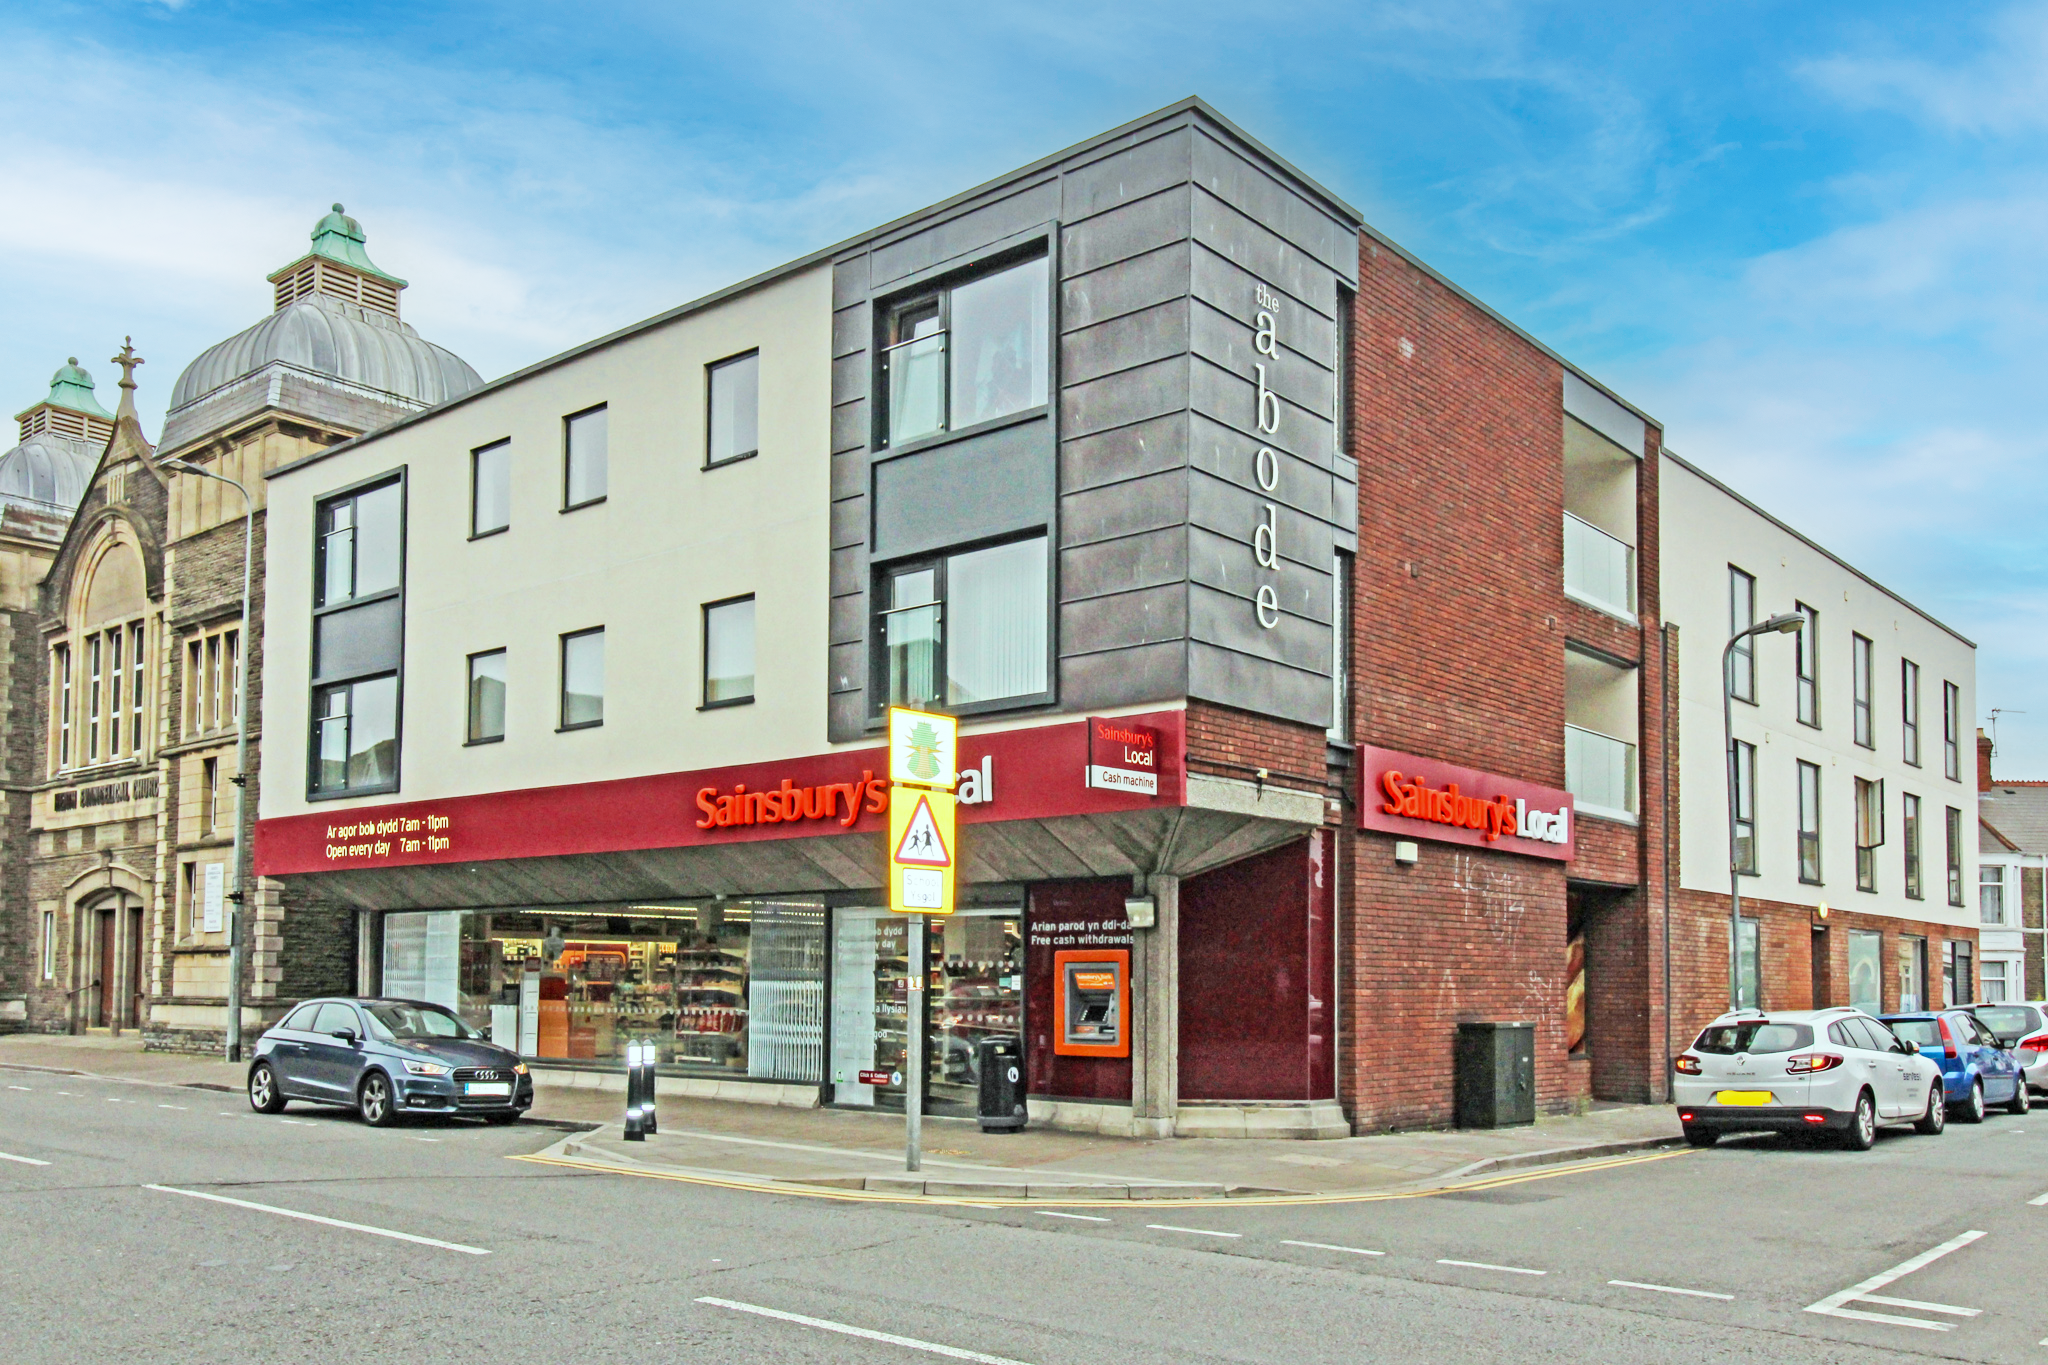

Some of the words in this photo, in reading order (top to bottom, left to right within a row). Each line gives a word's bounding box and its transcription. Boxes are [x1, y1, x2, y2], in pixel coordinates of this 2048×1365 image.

[1255, 283, 1280, 314] the
[1254, 310, 1281, 630] abode
[1097, 723, 1154, 749] Sainsbury's
[1124, 745, 1153, 767] Local
[133, 775, 160, 800] CHURC
[1102, 770, 1122, 784] Cash
[1123, 775, 1154, 789] machine
[696, 769, 888, 829] Sainsbury's
[1383, 770, 1516, 842] Sainsbury's
[1515, 798, 1569, 844] Local
[326, 825, 337, 839] Ar
[338, 824, 358, 841] agor
[359, 821, 376, 836] bob
[376, 818, 399, 837] dydd
[400, 817, 420, 832] 7am
[427, 814, 449, 832] 11pm
[326, 844, 348, 860] Open
[349, 843, 374, 858] every
[374, 840, 391, 857] day
[400, 837, 420, 852] 7am
[428, 835, 449, 853] 11pm
[1031, 921, 1057, 932] Arian
[1058, 920, 1085, 932] parod
[1088, 921, 1100, 932] yn
[881, 940, 896, 949] day
[1031, 935, 1051, 945] Free
[1053, 935, 1075, 944] cash
[1077, 934, 1134, 944] withdrawals
[875, 1005, 881, 1013] a
